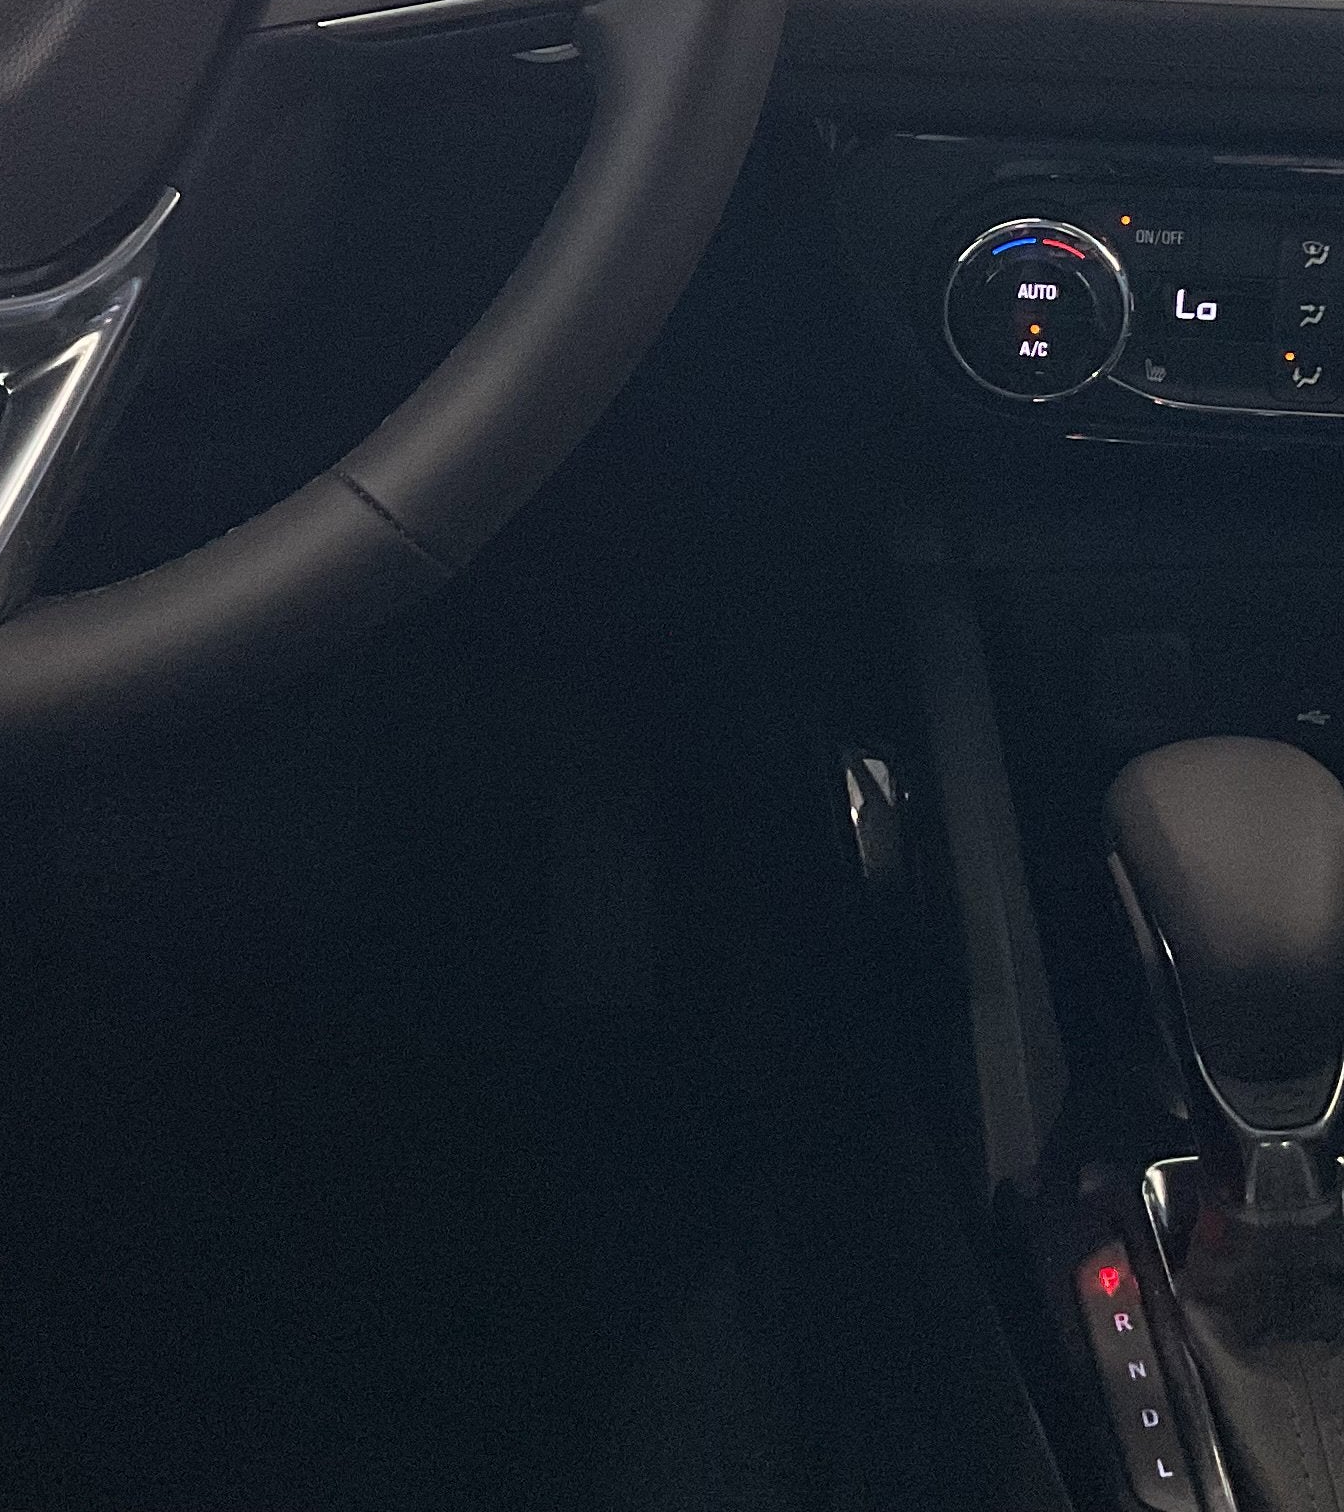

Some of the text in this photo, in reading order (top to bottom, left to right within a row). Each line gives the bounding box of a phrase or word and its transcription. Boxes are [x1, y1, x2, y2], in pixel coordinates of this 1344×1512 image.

[1136, 229, 1185, 246] ON/OFF
[1017, 283, 1057, 301] AUTO
[1175, 288, 1218, 321] Lo
[1019, 341, 1049, 358] A/C
[1113, 1312, 1133, 1332] R
[1128, 1360, 1147, 1379] N
[1141, 1408, 1159, 1428] D
[1156, 1458, 1173, 1478] L
